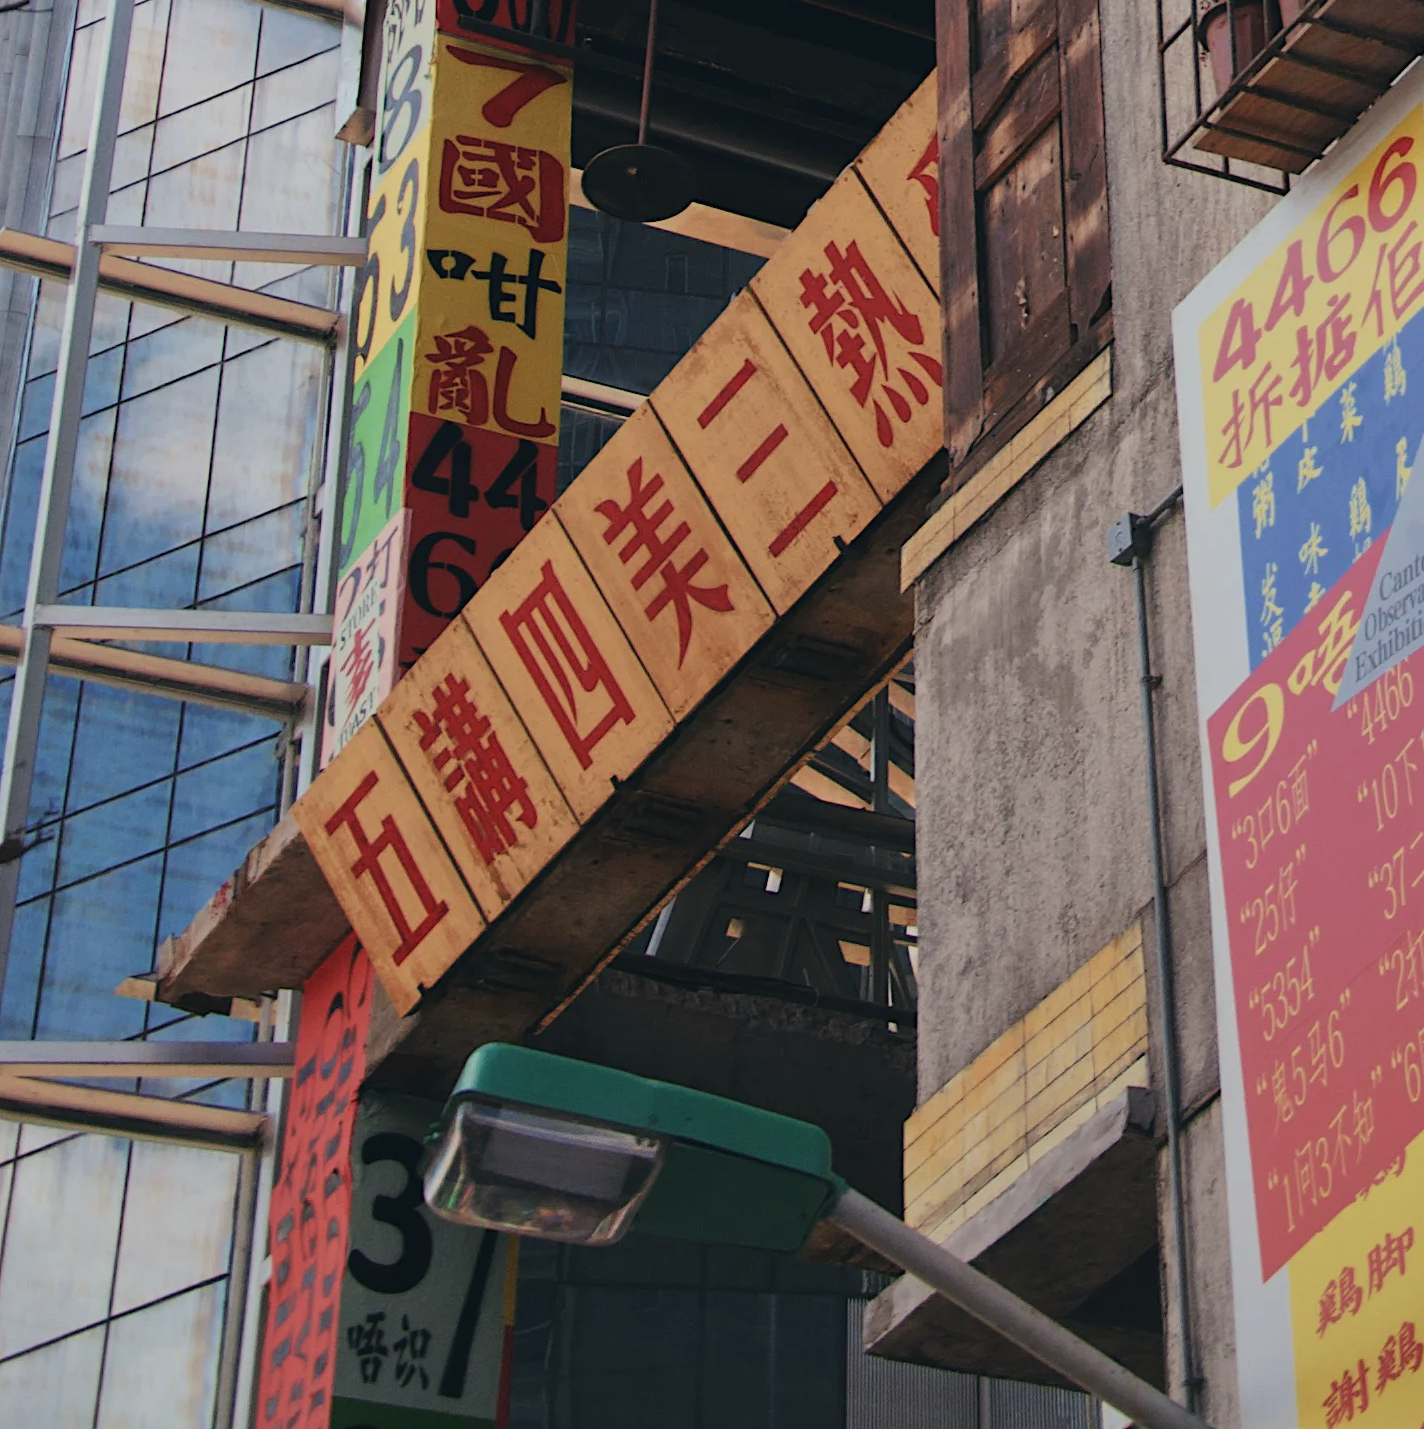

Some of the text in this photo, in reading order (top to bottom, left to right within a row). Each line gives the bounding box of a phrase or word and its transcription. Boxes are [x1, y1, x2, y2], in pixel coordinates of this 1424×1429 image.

[1214, 132, 1418, 381] 4466
[326, 133, 941, 967] 五講四美三熱
